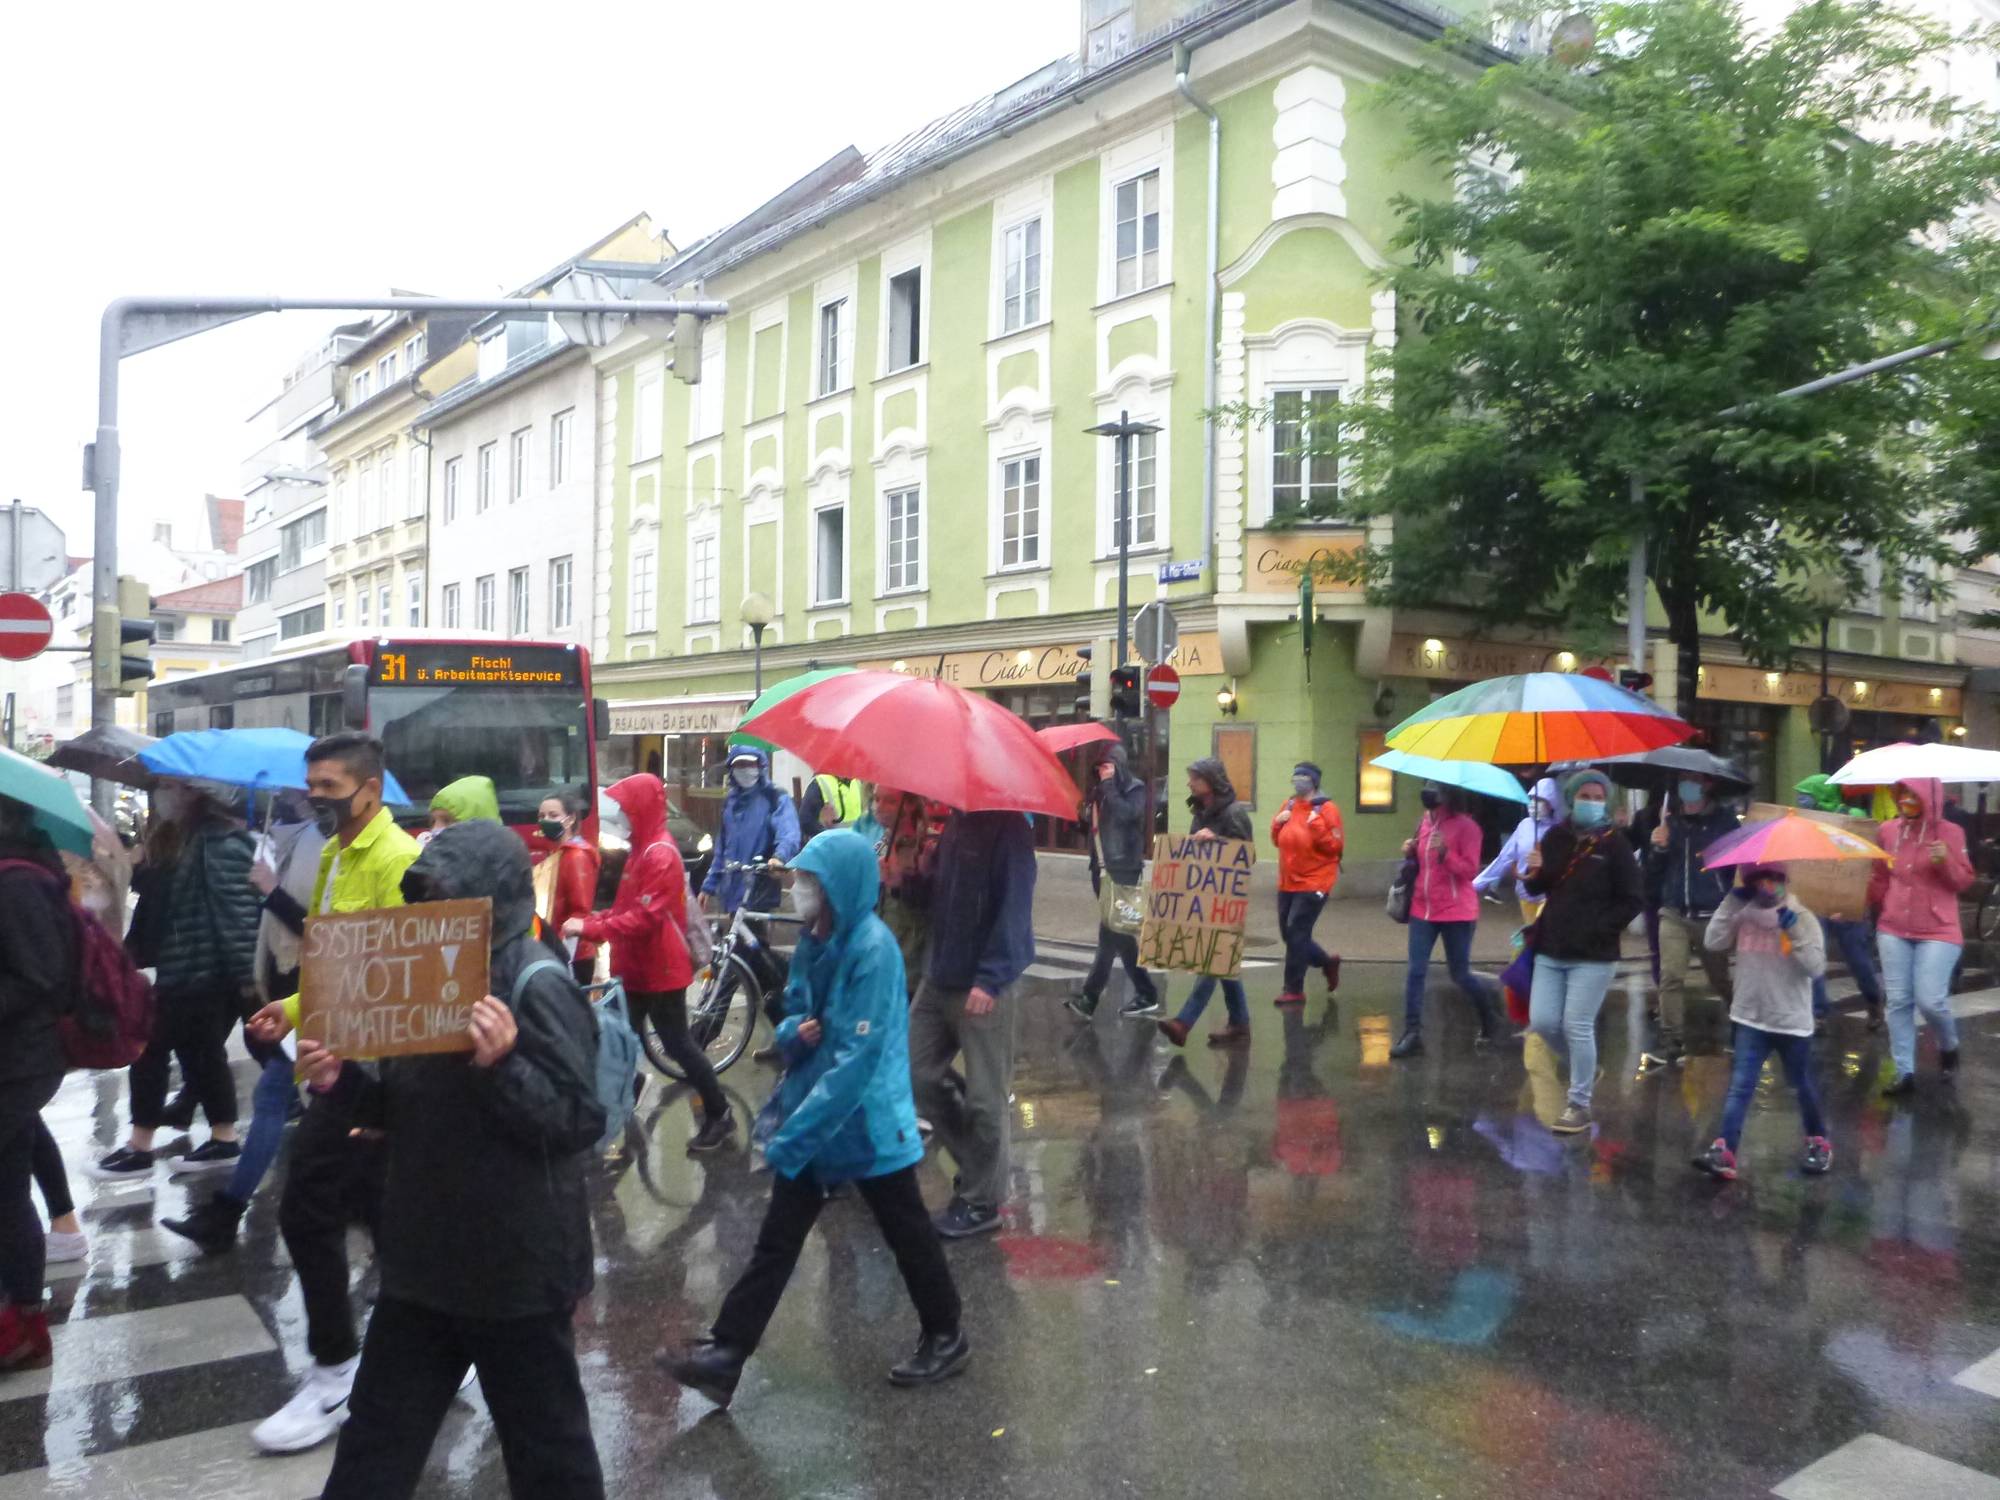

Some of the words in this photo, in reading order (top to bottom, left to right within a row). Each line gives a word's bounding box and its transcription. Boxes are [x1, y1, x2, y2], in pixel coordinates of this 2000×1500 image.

[381, 654, 407, 681] 31
[434, 669, 562, 682] Arbeitmarktservice
[979, 652, 1032, 684] Ciao
[1037, 647, 1093, 680] Ciao
[1405, 648, 1517, 674] RISTORANTE
[1158, 835, 1163, 859] I
[1168, 836, 1228, 863] WANT
[1233, 844, 1249, 868] A
[1186, 864, 1251, 896] DATE
[1150, 892, 1184, 920] NOT
[1187, 896, 1203, 922] A
[1211, 897, 1249, 924] HOT
[305, 917, 396, 958] SYSTEM
[401, 916, 481, 948] CHANGE
[335, 954, 424, 1004] NOT
[407, 1004, 472, 1040] CHANG
